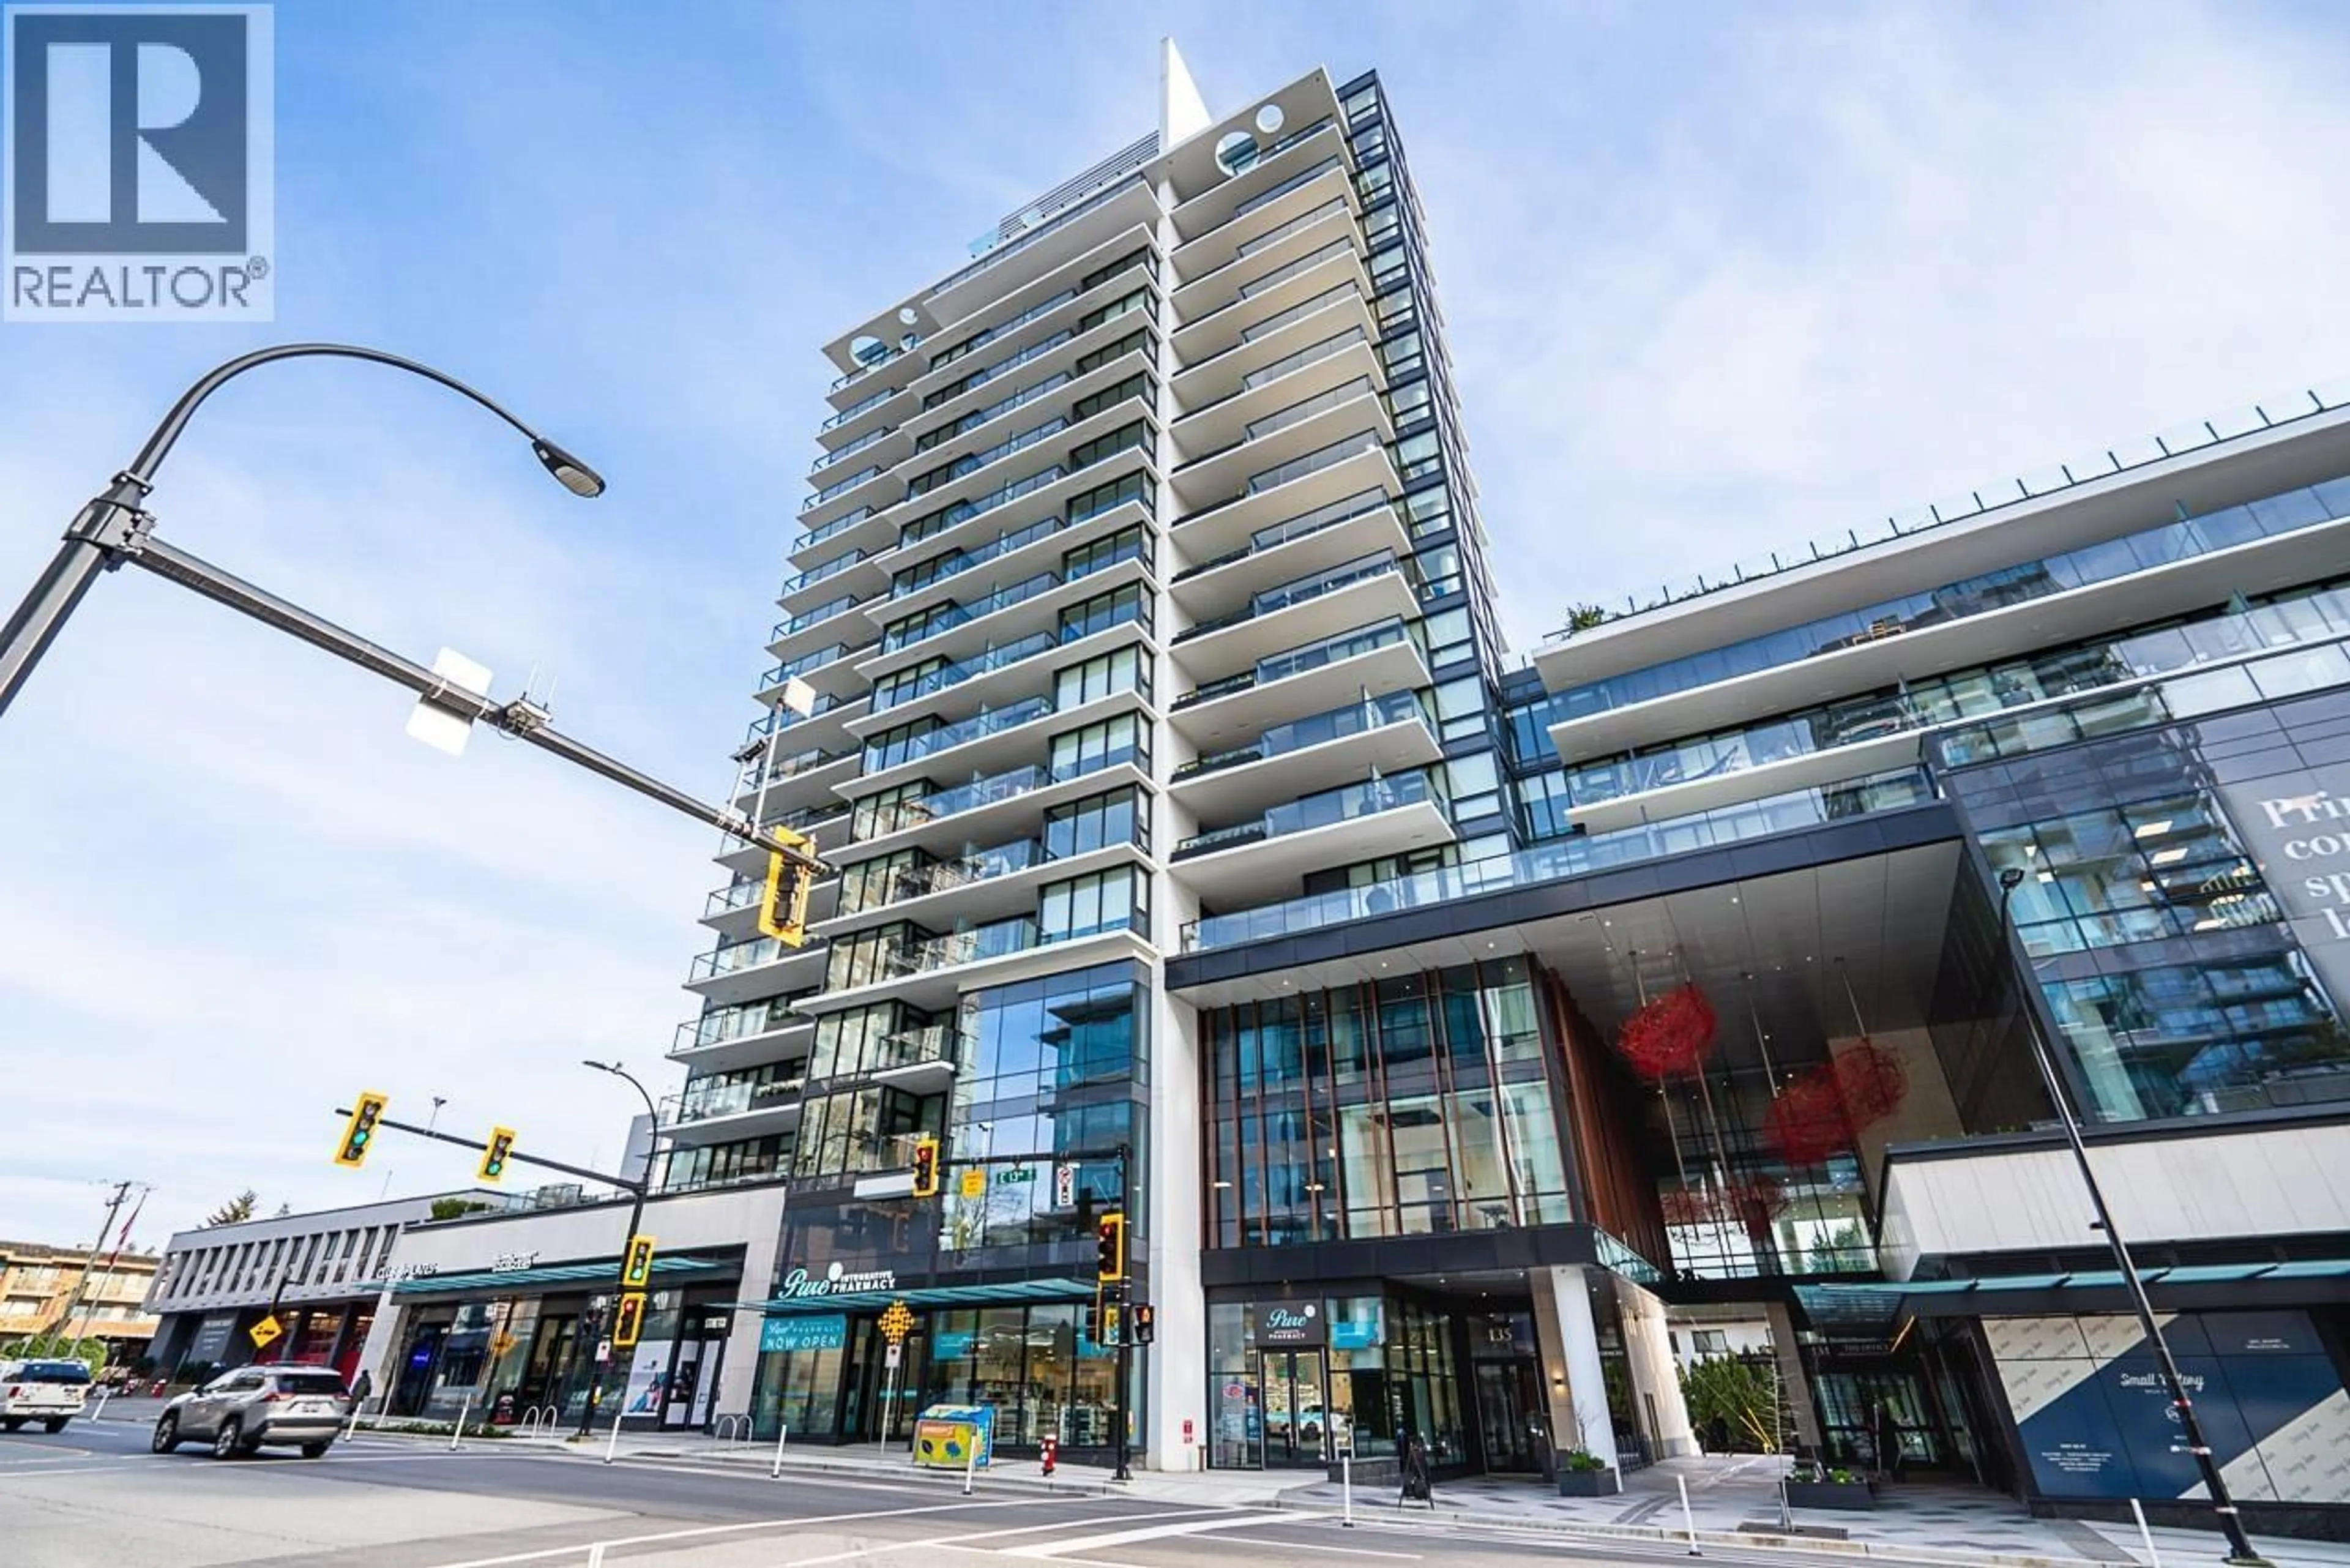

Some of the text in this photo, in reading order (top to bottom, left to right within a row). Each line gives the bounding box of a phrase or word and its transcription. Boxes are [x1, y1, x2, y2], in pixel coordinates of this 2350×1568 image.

[778, 1268, 830, 1299] Pure
[831, 1278, 895, 1293] PHARMACY
[1266, 1309, 1307, 1328] Pure
[766, 1335, 837, 1350] NOW OPEN
[2120, 1373, 2156, 1387] Small
